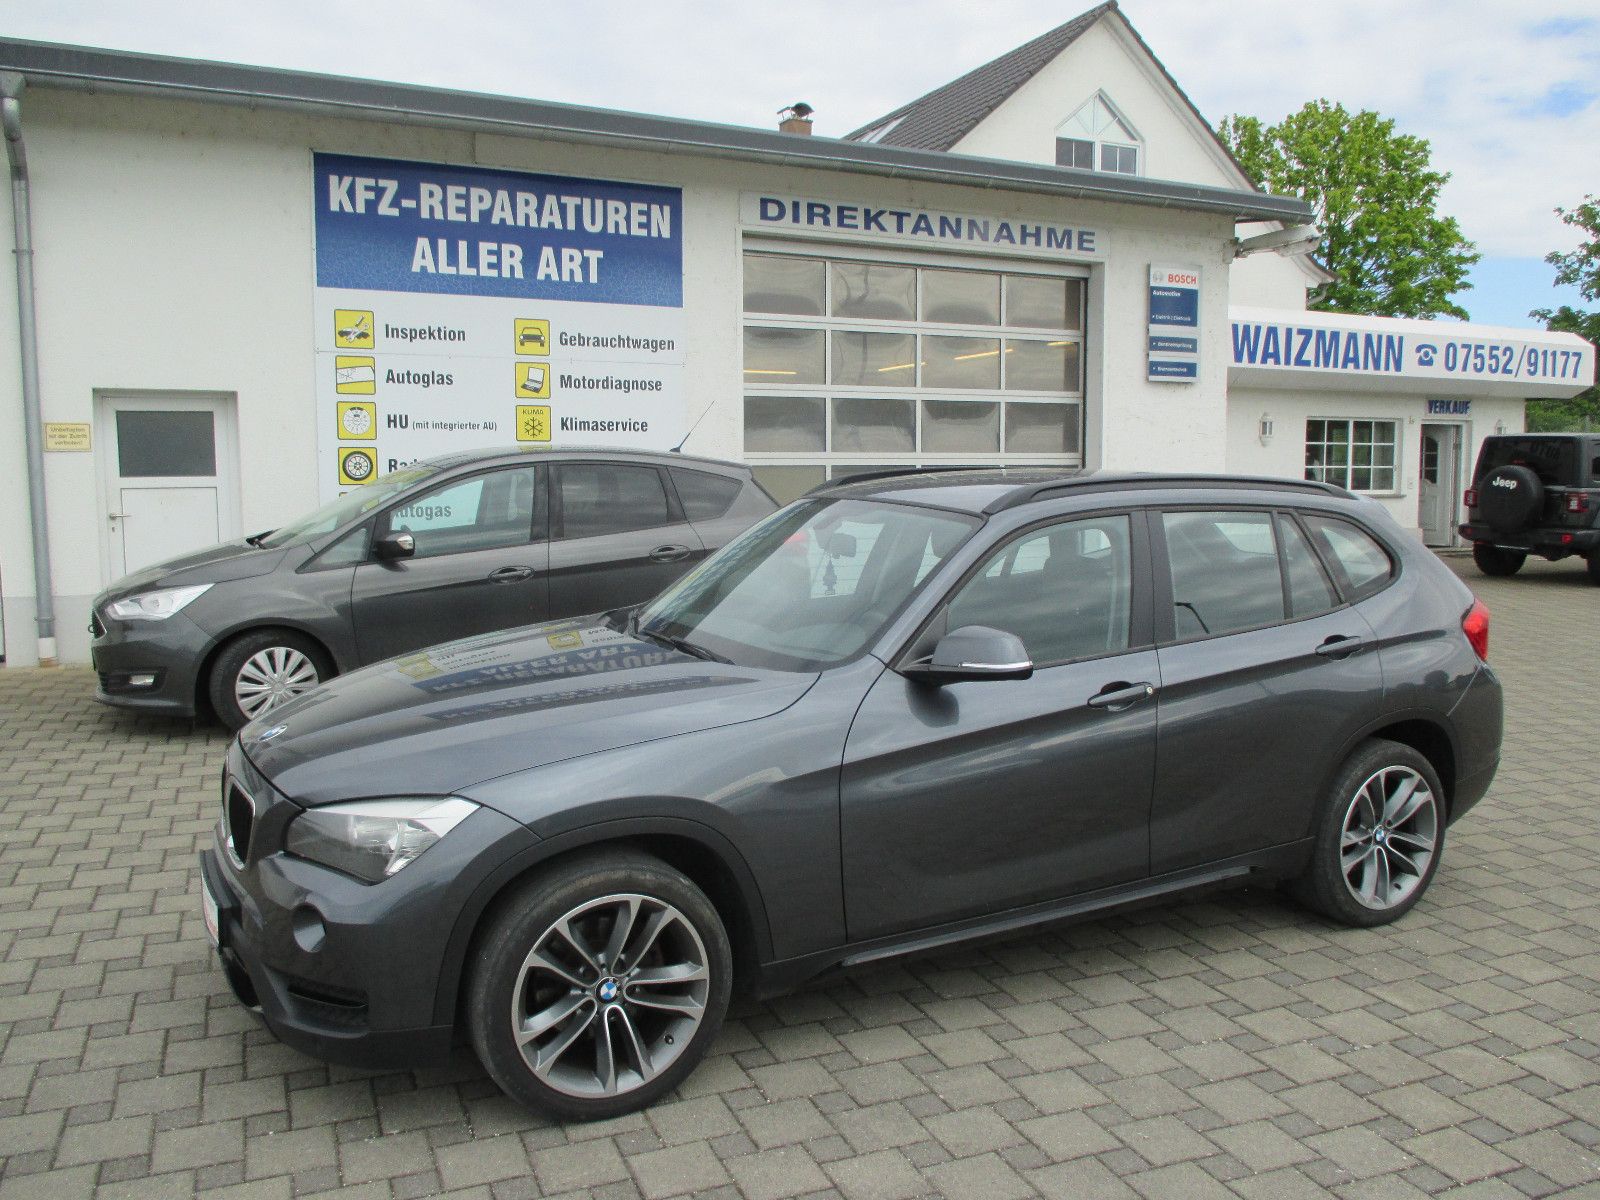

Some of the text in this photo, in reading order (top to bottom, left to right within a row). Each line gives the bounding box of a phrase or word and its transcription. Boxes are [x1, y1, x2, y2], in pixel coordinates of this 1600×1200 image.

[328, 174, 672, 239] KFZ-REPARATUREN
[759, 197, 1096, 252] DIREKTANNAHME
[411, 236, 604, 284] ALLER ART
[1167, 273, 1197, 285] BOSCH
[384, 323, 467, 343] Inspektion
[558, 331, 676, 353] Gebrauchtwagen
[1231, 323, 1583, 379] WAIZMANN 07552/91177
[385, 369, 454, 388] Autoglas
[559, 374, 663, 394] Motordiagnose
[1427, 399, 1471, 414] VERKAUF
[387, 414, 498, 433] HU (mit integrierter AU)
[560, 416, 649, 433] Klimaservice
[1492, 477, 1518, 490] Jeep
[394, 505, 452, 521] utogas
